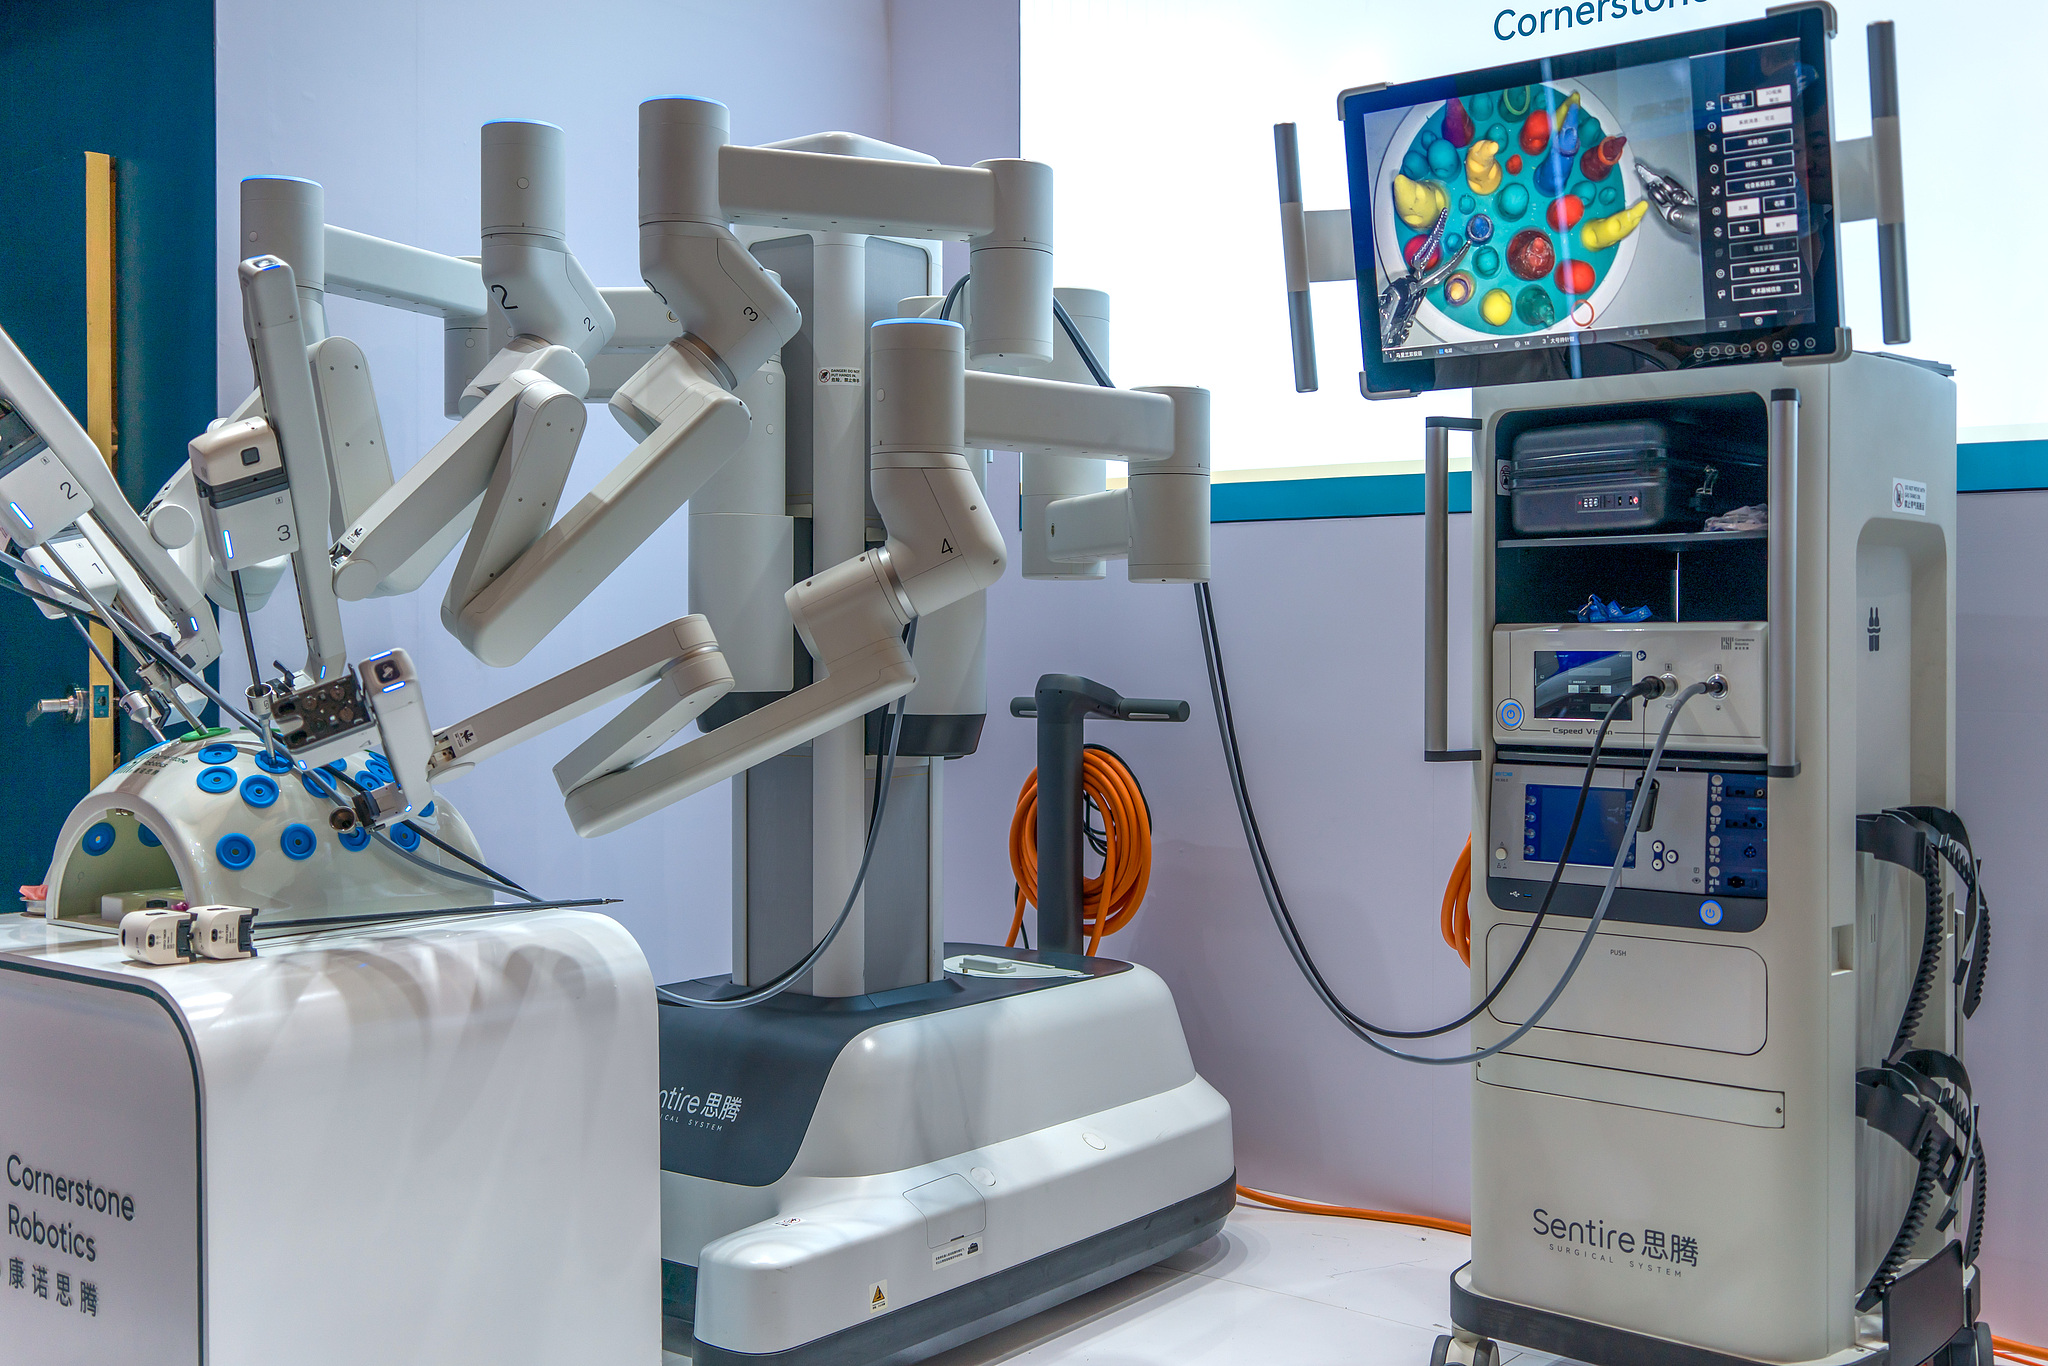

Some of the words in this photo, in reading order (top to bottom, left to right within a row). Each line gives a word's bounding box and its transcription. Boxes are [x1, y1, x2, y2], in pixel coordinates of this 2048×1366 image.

[491, 284, 518, 310] 2
[743, 306, 759, 322] 3
[583, 316, 595, 332] 2
[60, 481, 78, 500] 2
[277, 524, 291, 541] 3
[941, 537, 954, 554] 4
[91, 562, 103, 575] 1
[1552, 727, 1583, 735] Cspeed
[659, 1086, 701, 1114] ntire
[700, 1091, 743, 1123] 思腾
[688, 1118, 723, 1132] SYSTEM
[6, 1154, 135, 1221] Cornerstone
[8, 1203, 96, 1262] Robotics
[1533, 1208, 1636, 1254] Sentire
[1641, 1228, 1699, 1267] 思腾
[1549, 1243, 1614, 1264] SURGICAL
[1629, 1260, 1682, 1278] SYSTEM
[8, 1256, 99, 1318] 康诺思腾
